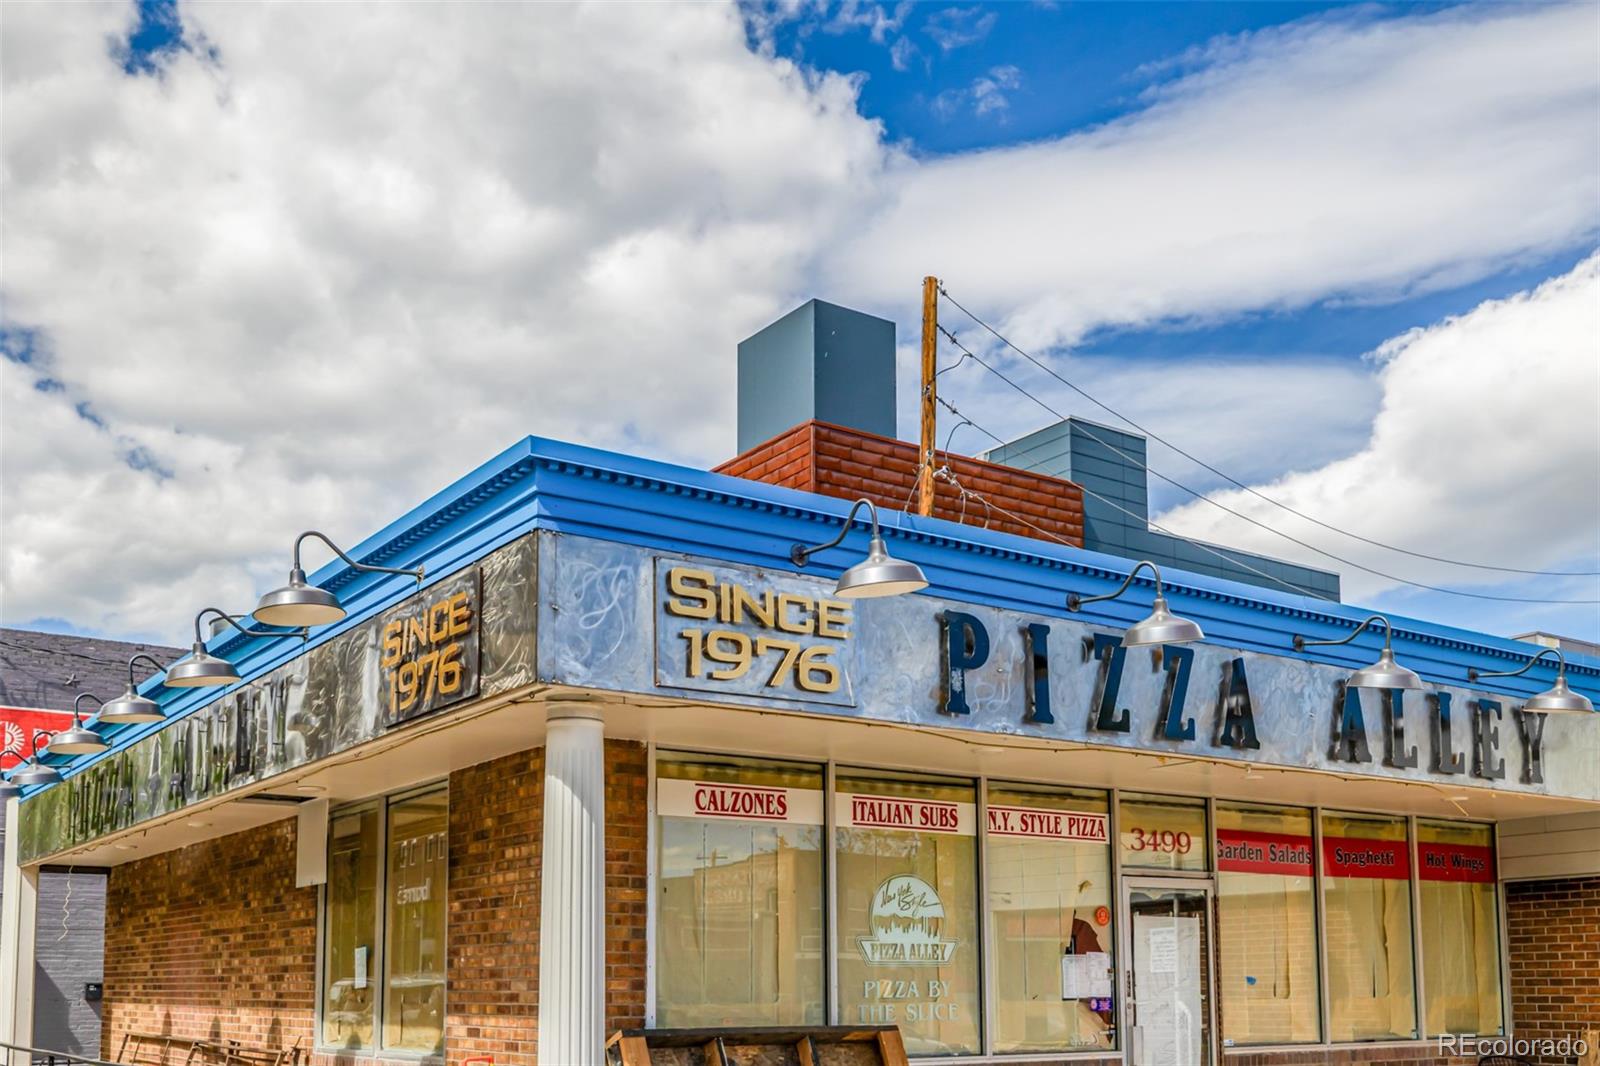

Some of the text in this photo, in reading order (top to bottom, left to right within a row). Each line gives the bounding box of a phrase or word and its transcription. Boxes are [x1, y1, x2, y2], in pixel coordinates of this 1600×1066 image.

[666, 567, 852, 639] SINCE
[382, 591, 470, 669] SINCE
[680, 629, 840, 693] 1976
[389, 642, 461, 714] 1976
[939, 609, 1544, 785] PIZZA ALLEY
[694, 788, 788, 816] CALZONES
[852, 800, 959, 828] ITALIAN SUBS
[988, 810, 1105, 838] N.Y. STYLE PIZZA
[1130, 828, 1191, 854] 3499
[1269, 843, 1312, 865] Salads
[1335, 847, 1395, 869] Spaghetti
[1426, 853, 1485, 872] Hot Wings
[900, 891, 940, 916] Style
[871, 943, 947, 960] PIZZA ALLEY
[864, 980, 952, 999] PIZZA BY
[857, 1003, 960, 1023] THE SLICE
